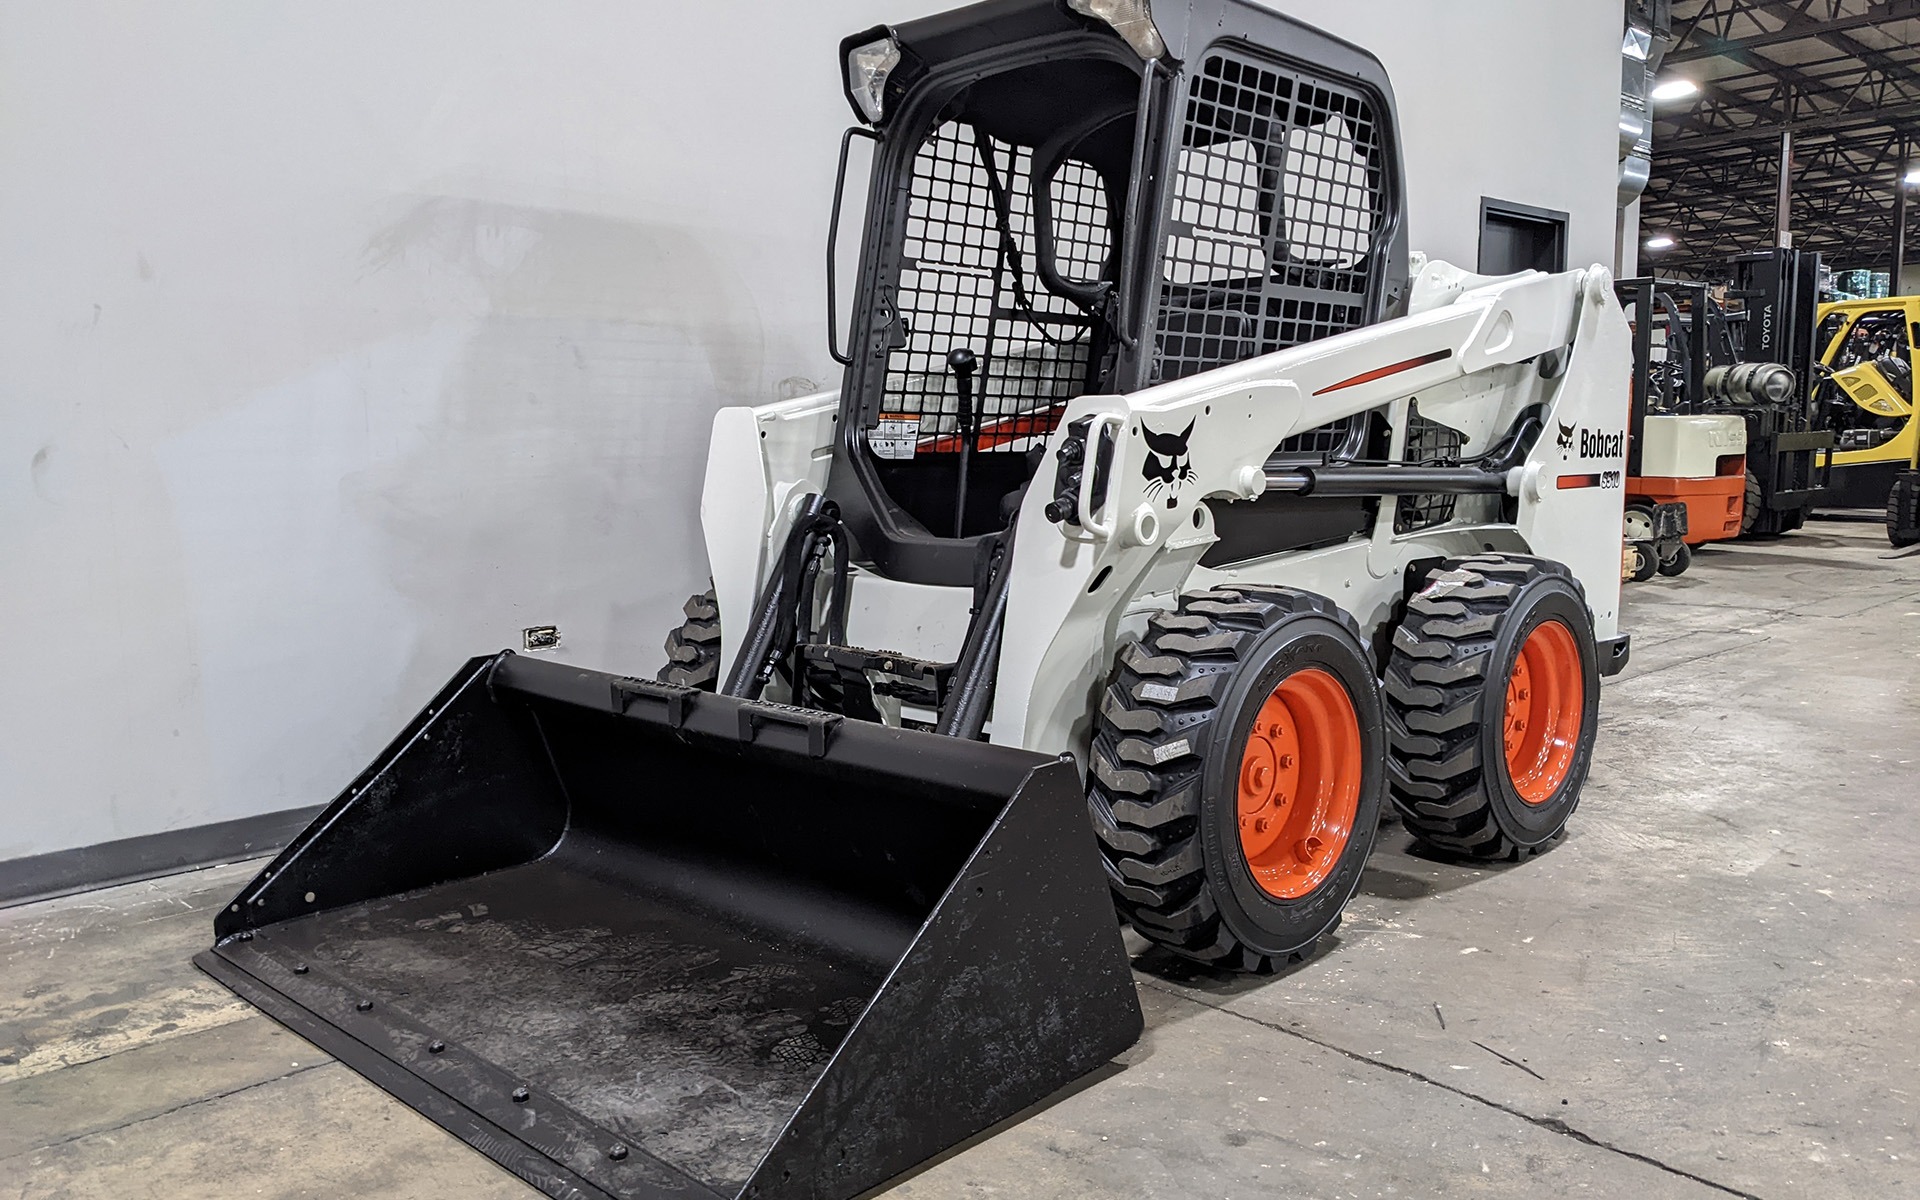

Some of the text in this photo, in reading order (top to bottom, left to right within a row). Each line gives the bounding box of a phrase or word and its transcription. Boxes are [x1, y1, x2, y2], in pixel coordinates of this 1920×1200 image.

[1761, 304, 1772, 351] TOYOTA
[1580, 428, 1623, 459] Bobcat
[1601, 470, 1621, 490] S510
